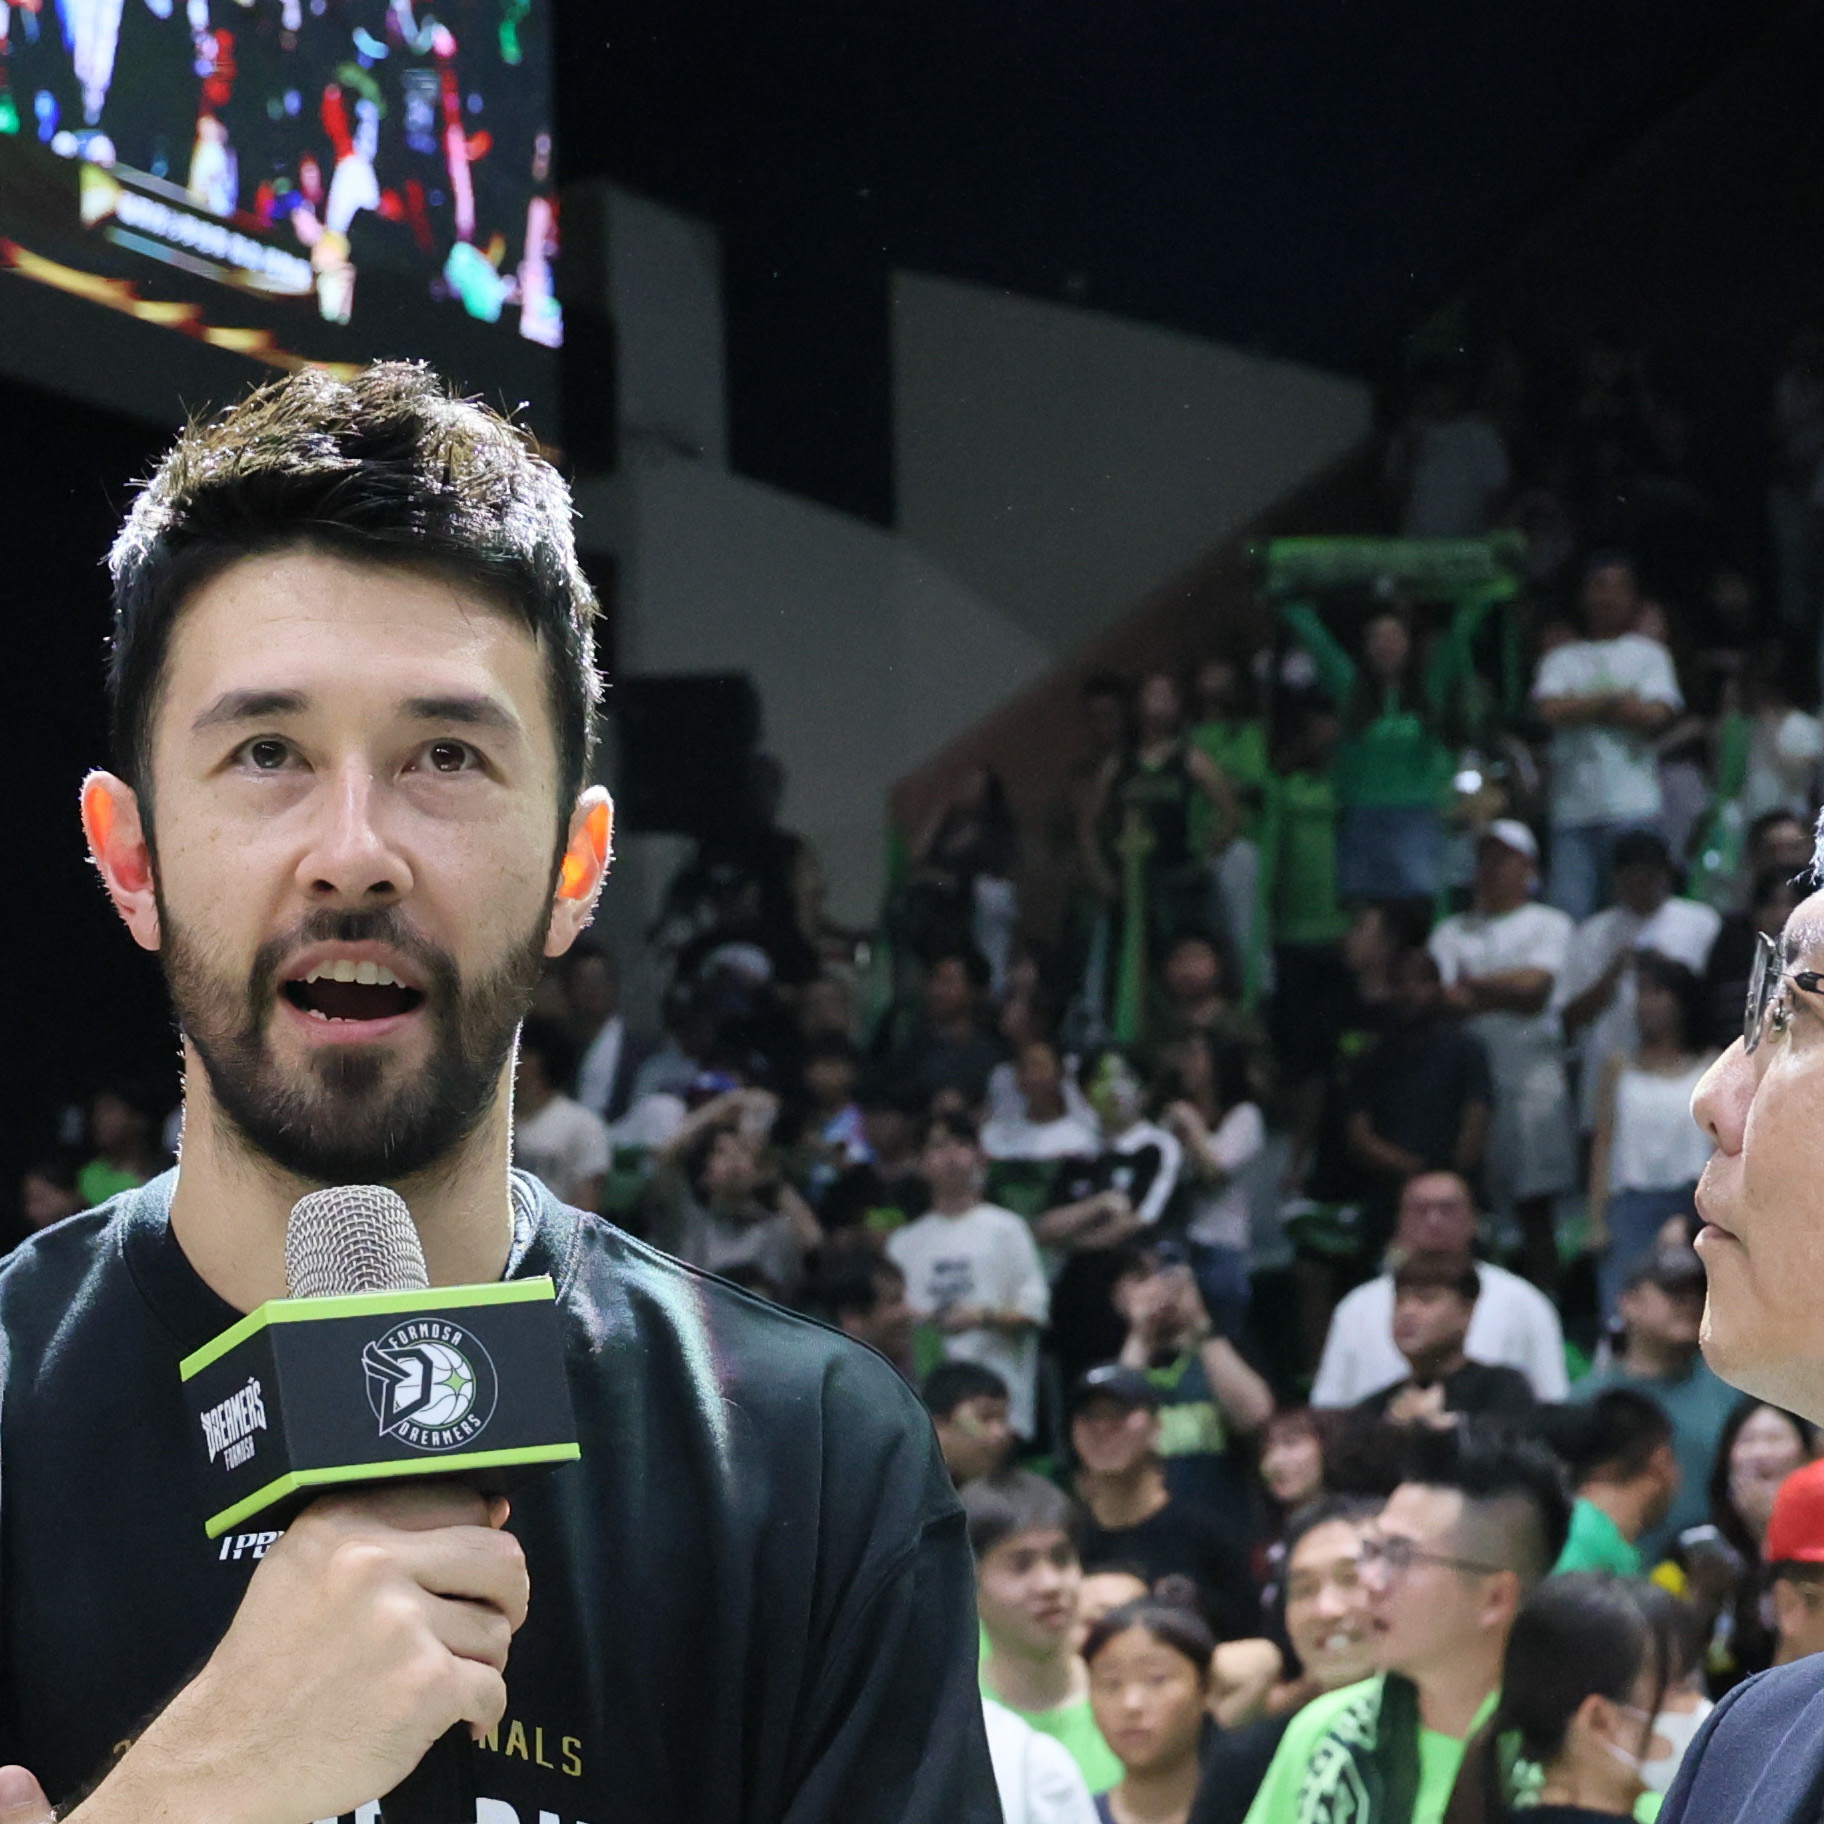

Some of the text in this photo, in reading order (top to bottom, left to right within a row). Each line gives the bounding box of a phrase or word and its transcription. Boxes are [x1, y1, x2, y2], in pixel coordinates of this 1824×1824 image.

[388, 1323, 463, 1347] FORMOSA
[200, 1376, 267, 1464] DREAMERS
[398, 1413, 482, 1446] DREAMERS
